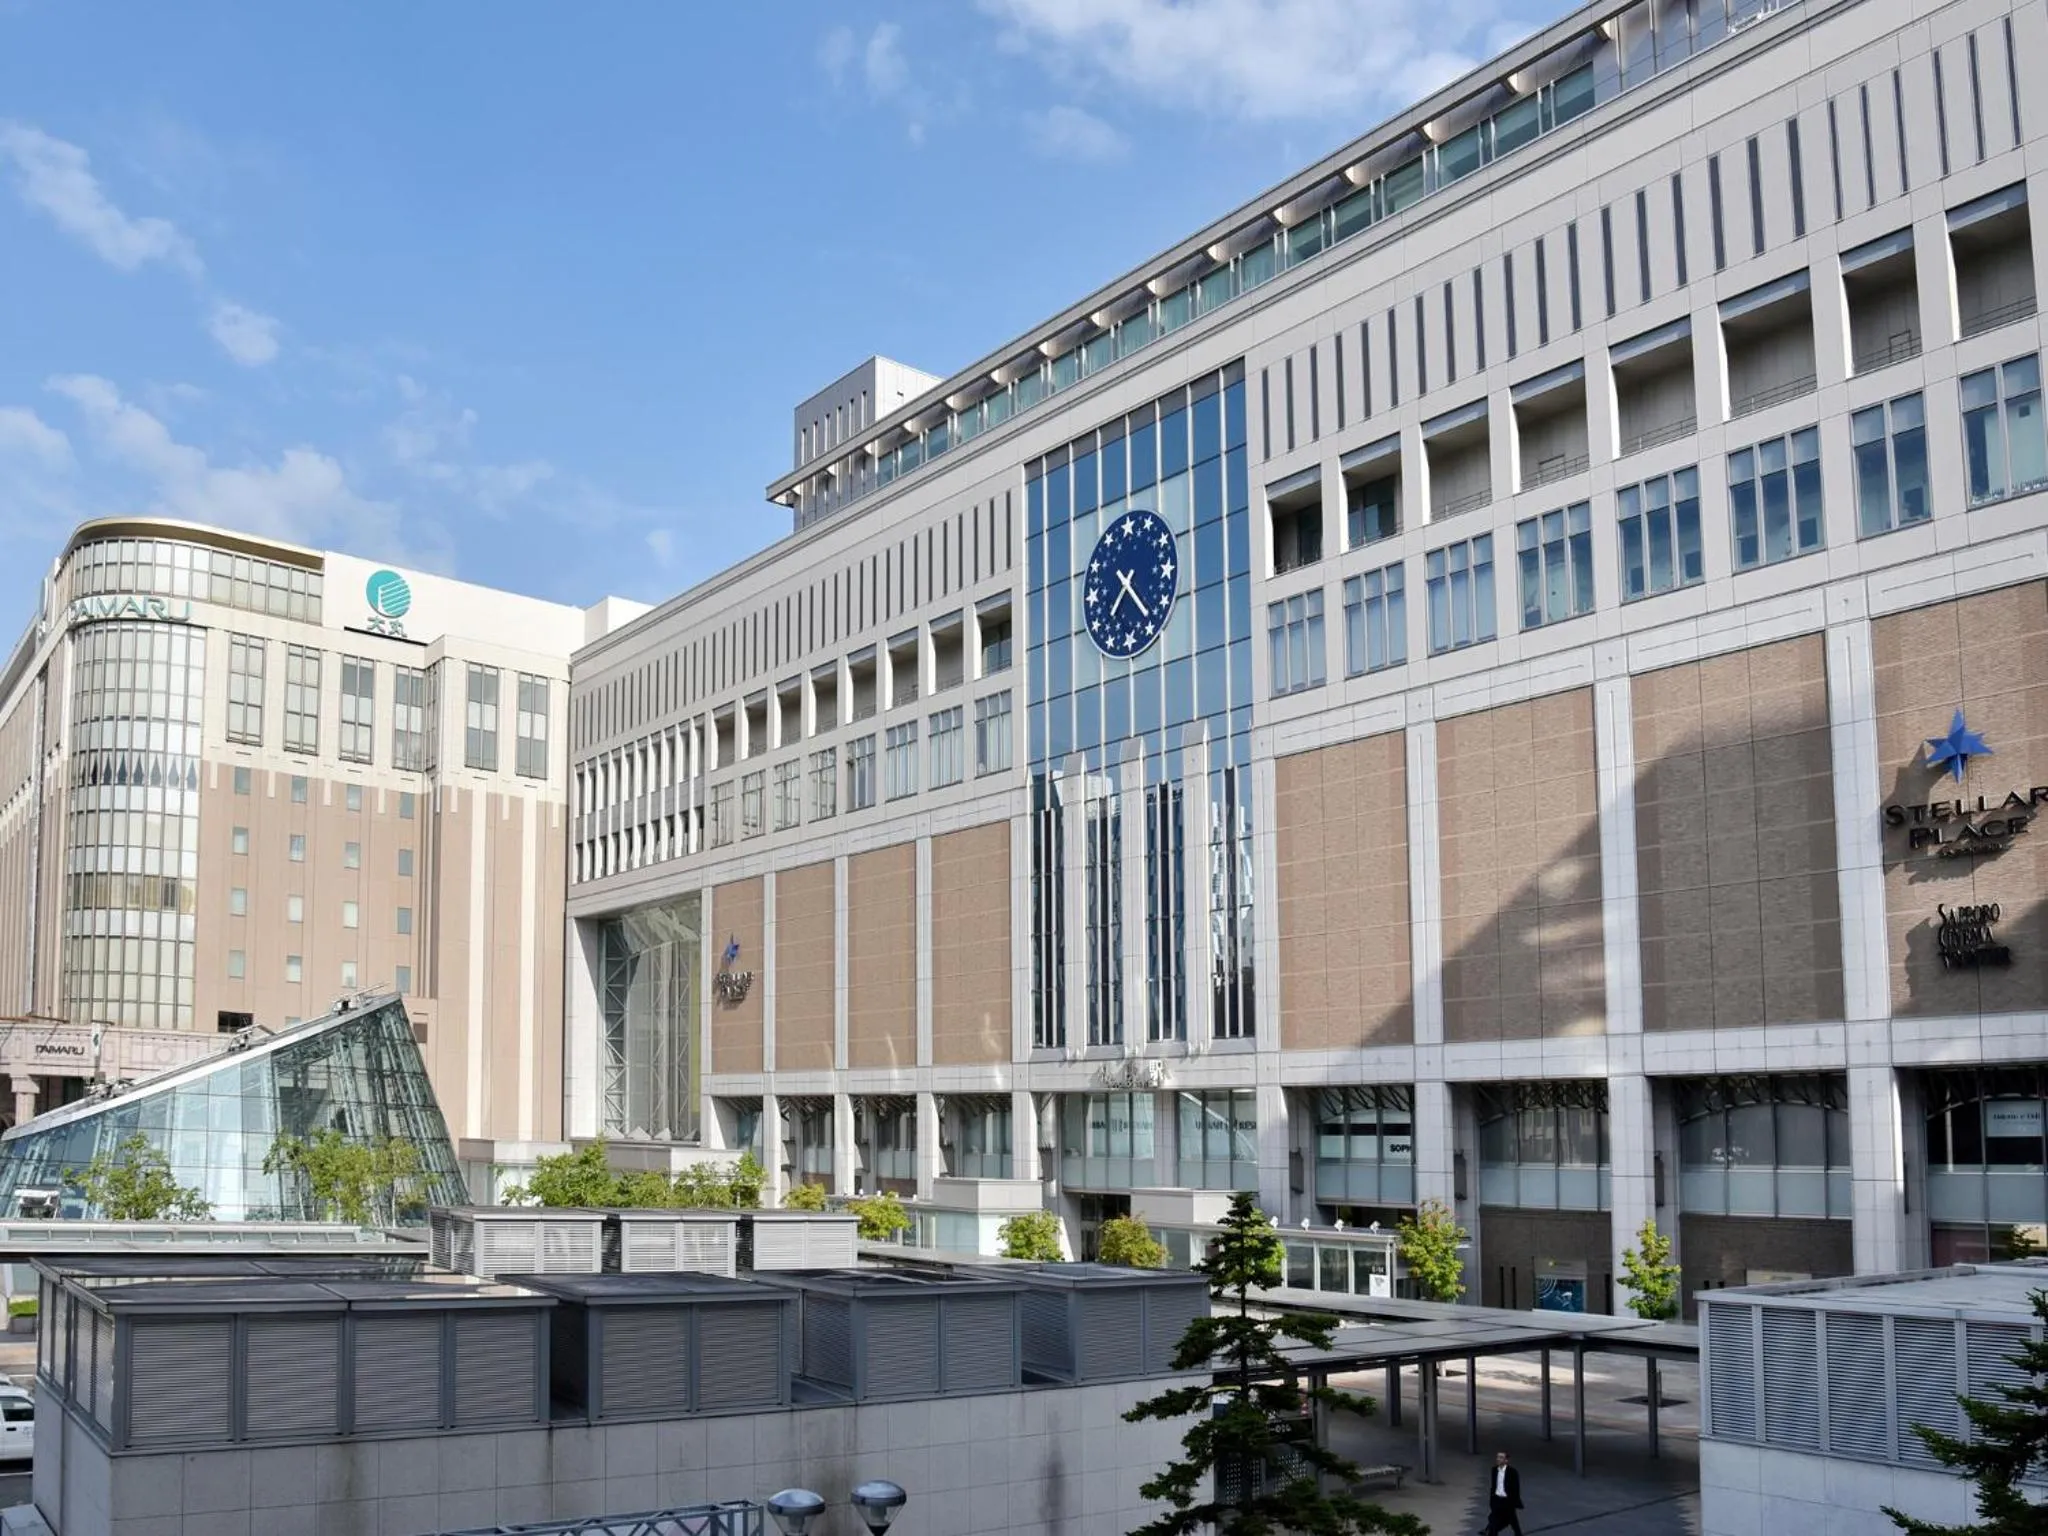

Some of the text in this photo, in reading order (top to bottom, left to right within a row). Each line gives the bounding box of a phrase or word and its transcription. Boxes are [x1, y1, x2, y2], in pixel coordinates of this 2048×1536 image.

[67, 596, 192, 622] DAIMARU
[366, 616, 408, 638] 大丸
[1886, 786, 2048, 827] STELLAR
[1910, 817, 2029, 849] PLACE
[35, 1044, 85, 1056] DAIMARU
